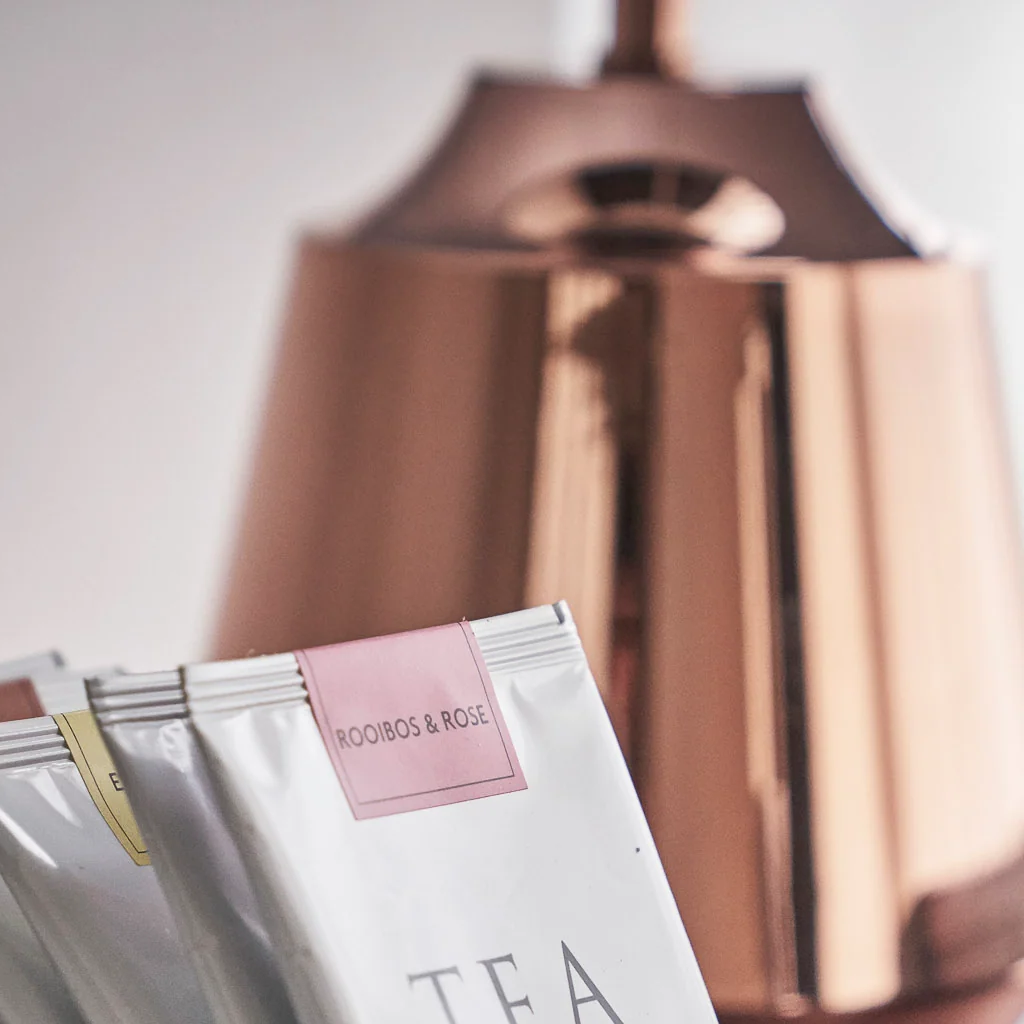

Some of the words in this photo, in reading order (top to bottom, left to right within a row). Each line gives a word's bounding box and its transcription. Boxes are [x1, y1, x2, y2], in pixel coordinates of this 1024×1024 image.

[335, 716, 421, 750] ROOIBOS
[425, 713, 440, 734] &
[441, 704, 489, 731] ROSE
